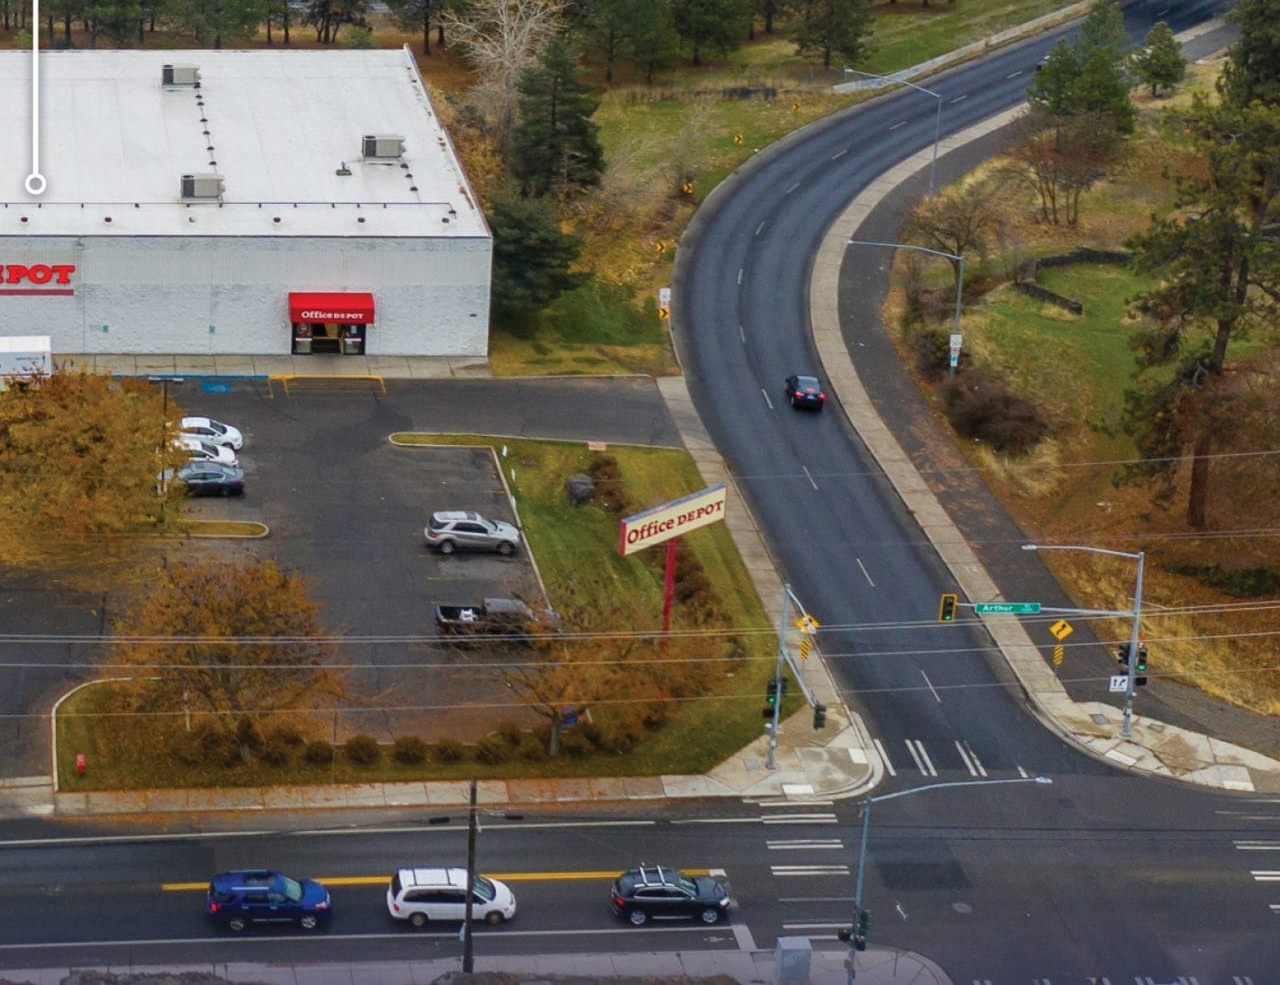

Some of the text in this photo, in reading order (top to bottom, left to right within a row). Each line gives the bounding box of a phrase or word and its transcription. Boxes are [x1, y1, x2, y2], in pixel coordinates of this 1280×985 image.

[301, 311, 332, 319] Office
[627, 501, 723, 544] Office DEPOT
[982, 604, 1014, 612] Arthur
